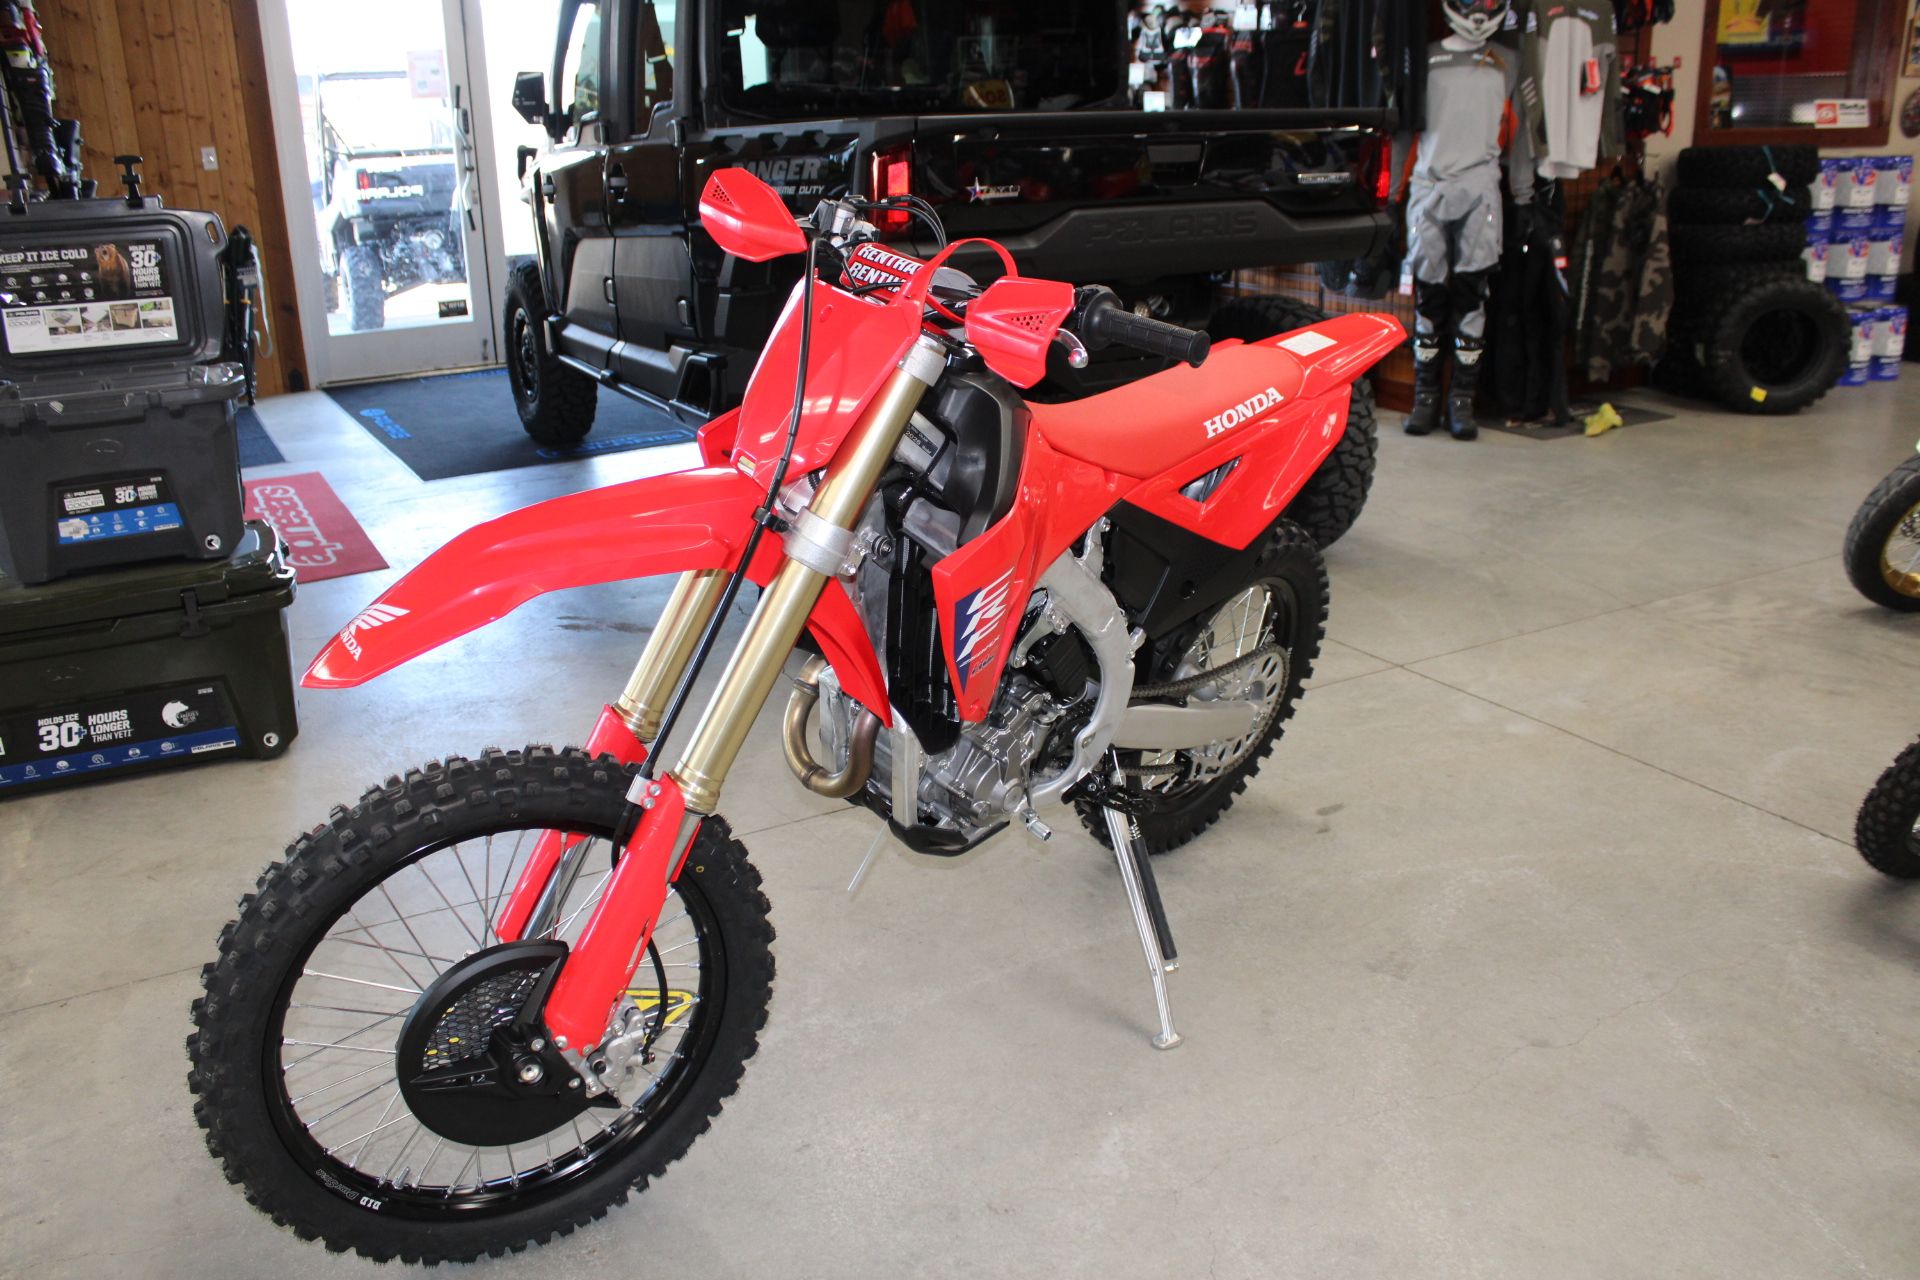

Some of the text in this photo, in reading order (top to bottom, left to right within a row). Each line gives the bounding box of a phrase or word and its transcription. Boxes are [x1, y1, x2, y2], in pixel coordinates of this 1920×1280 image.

[733, 158, 820, 181] ANGER
[798, 185, 825, 195] DUTY
[1087, 208, 1258, 248] POLARIS
[0, 248, 88, 264] KEEP IT ICE COLD
[845, 262, 907, 293] RENTH
[1203, 387, 1284, 439] HONDA
[340, 627, 362, 661] NDA
[38, 713, 79, 727] HOLDS ICE
[88, 709, 128, 726] HOURS
[90, 720, 130, 735] LONGER
[92, 730, 132, 743] THAN YETI
